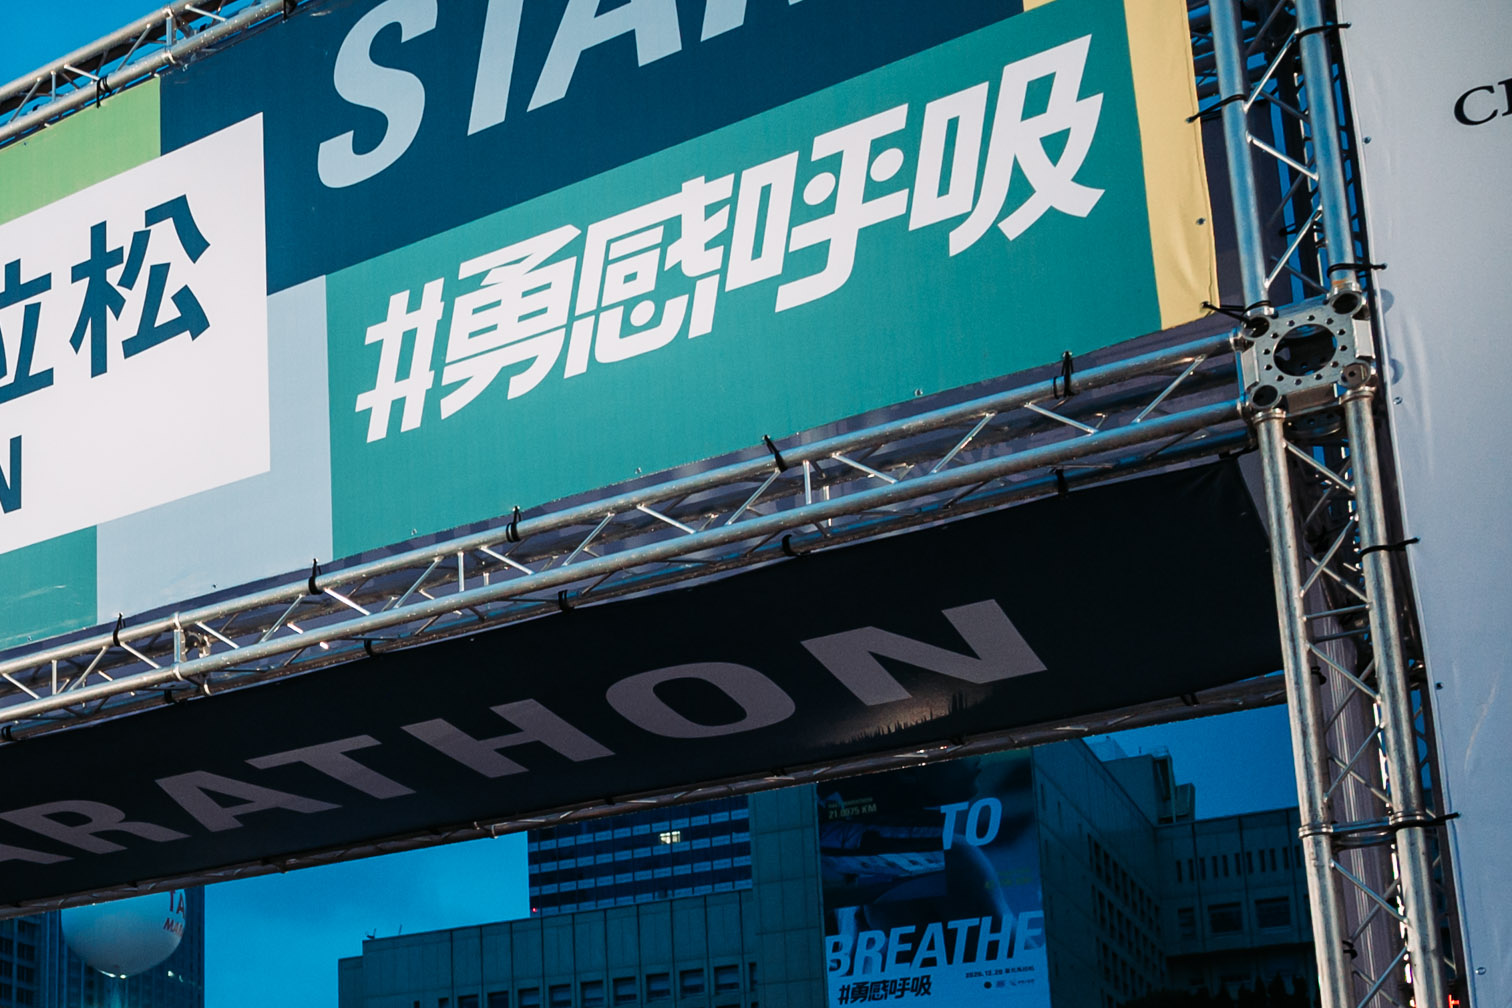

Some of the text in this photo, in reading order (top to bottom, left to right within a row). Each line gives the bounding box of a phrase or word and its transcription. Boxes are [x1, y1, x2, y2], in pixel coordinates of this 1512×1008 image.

[317, 0, 793, 189] STA
[355, 33, 1106, 445] #勇感呼吸
[940, 797, 1002, 850] TO
[825, 910, 1045, 978] BREATHE
[838, 975, 932, 1006] #勇感呼吸
